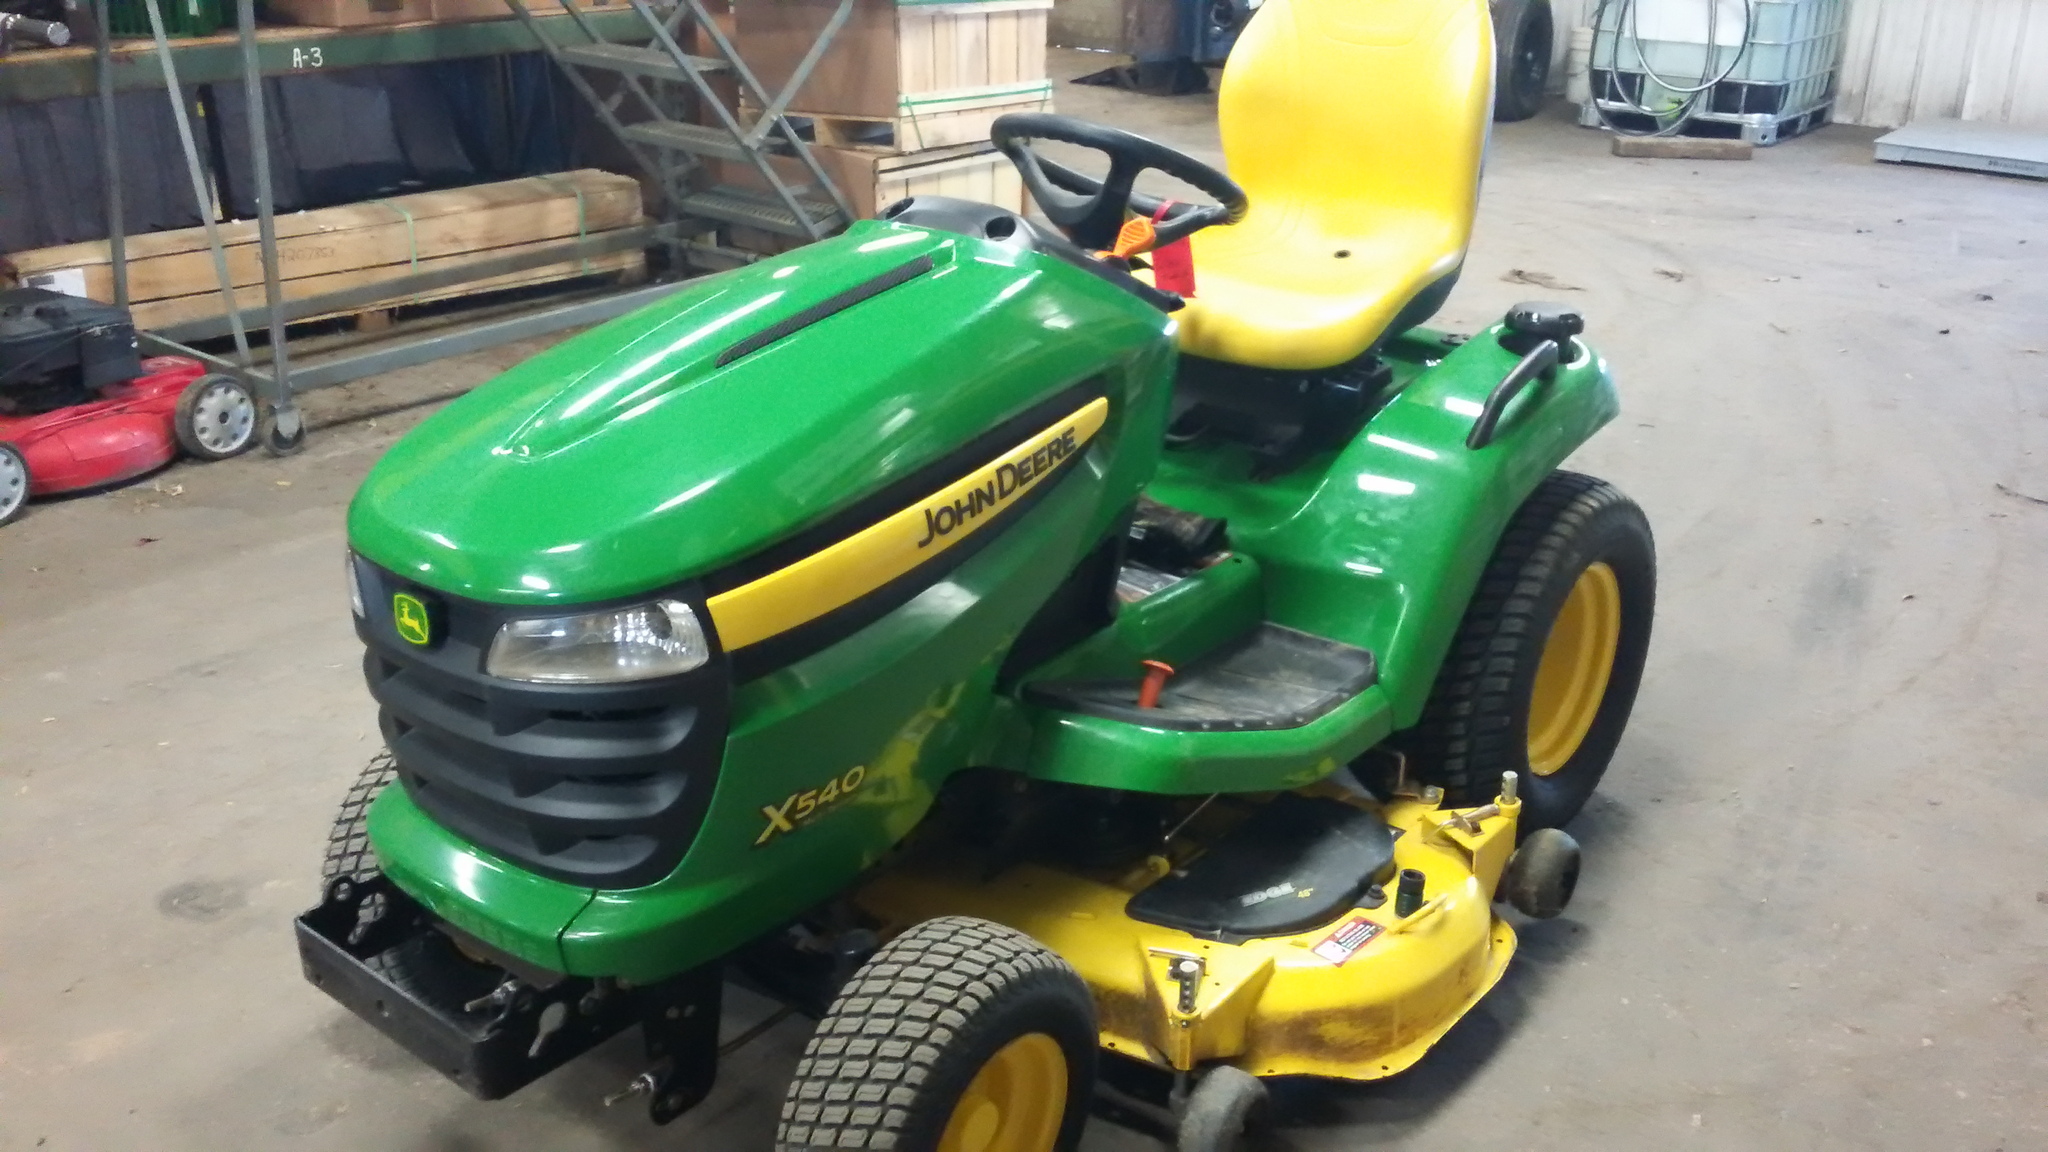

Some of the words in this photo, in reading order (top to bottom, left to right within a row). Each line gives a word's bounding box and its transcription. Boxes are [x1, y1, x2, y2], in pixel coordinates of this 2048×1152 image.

[293, 47, 323, 68] A-3
[918, 480, 995, 548] JOHN
[995, 426, 1077, 500] DEERE
[754, 765, 865, 846] X540
